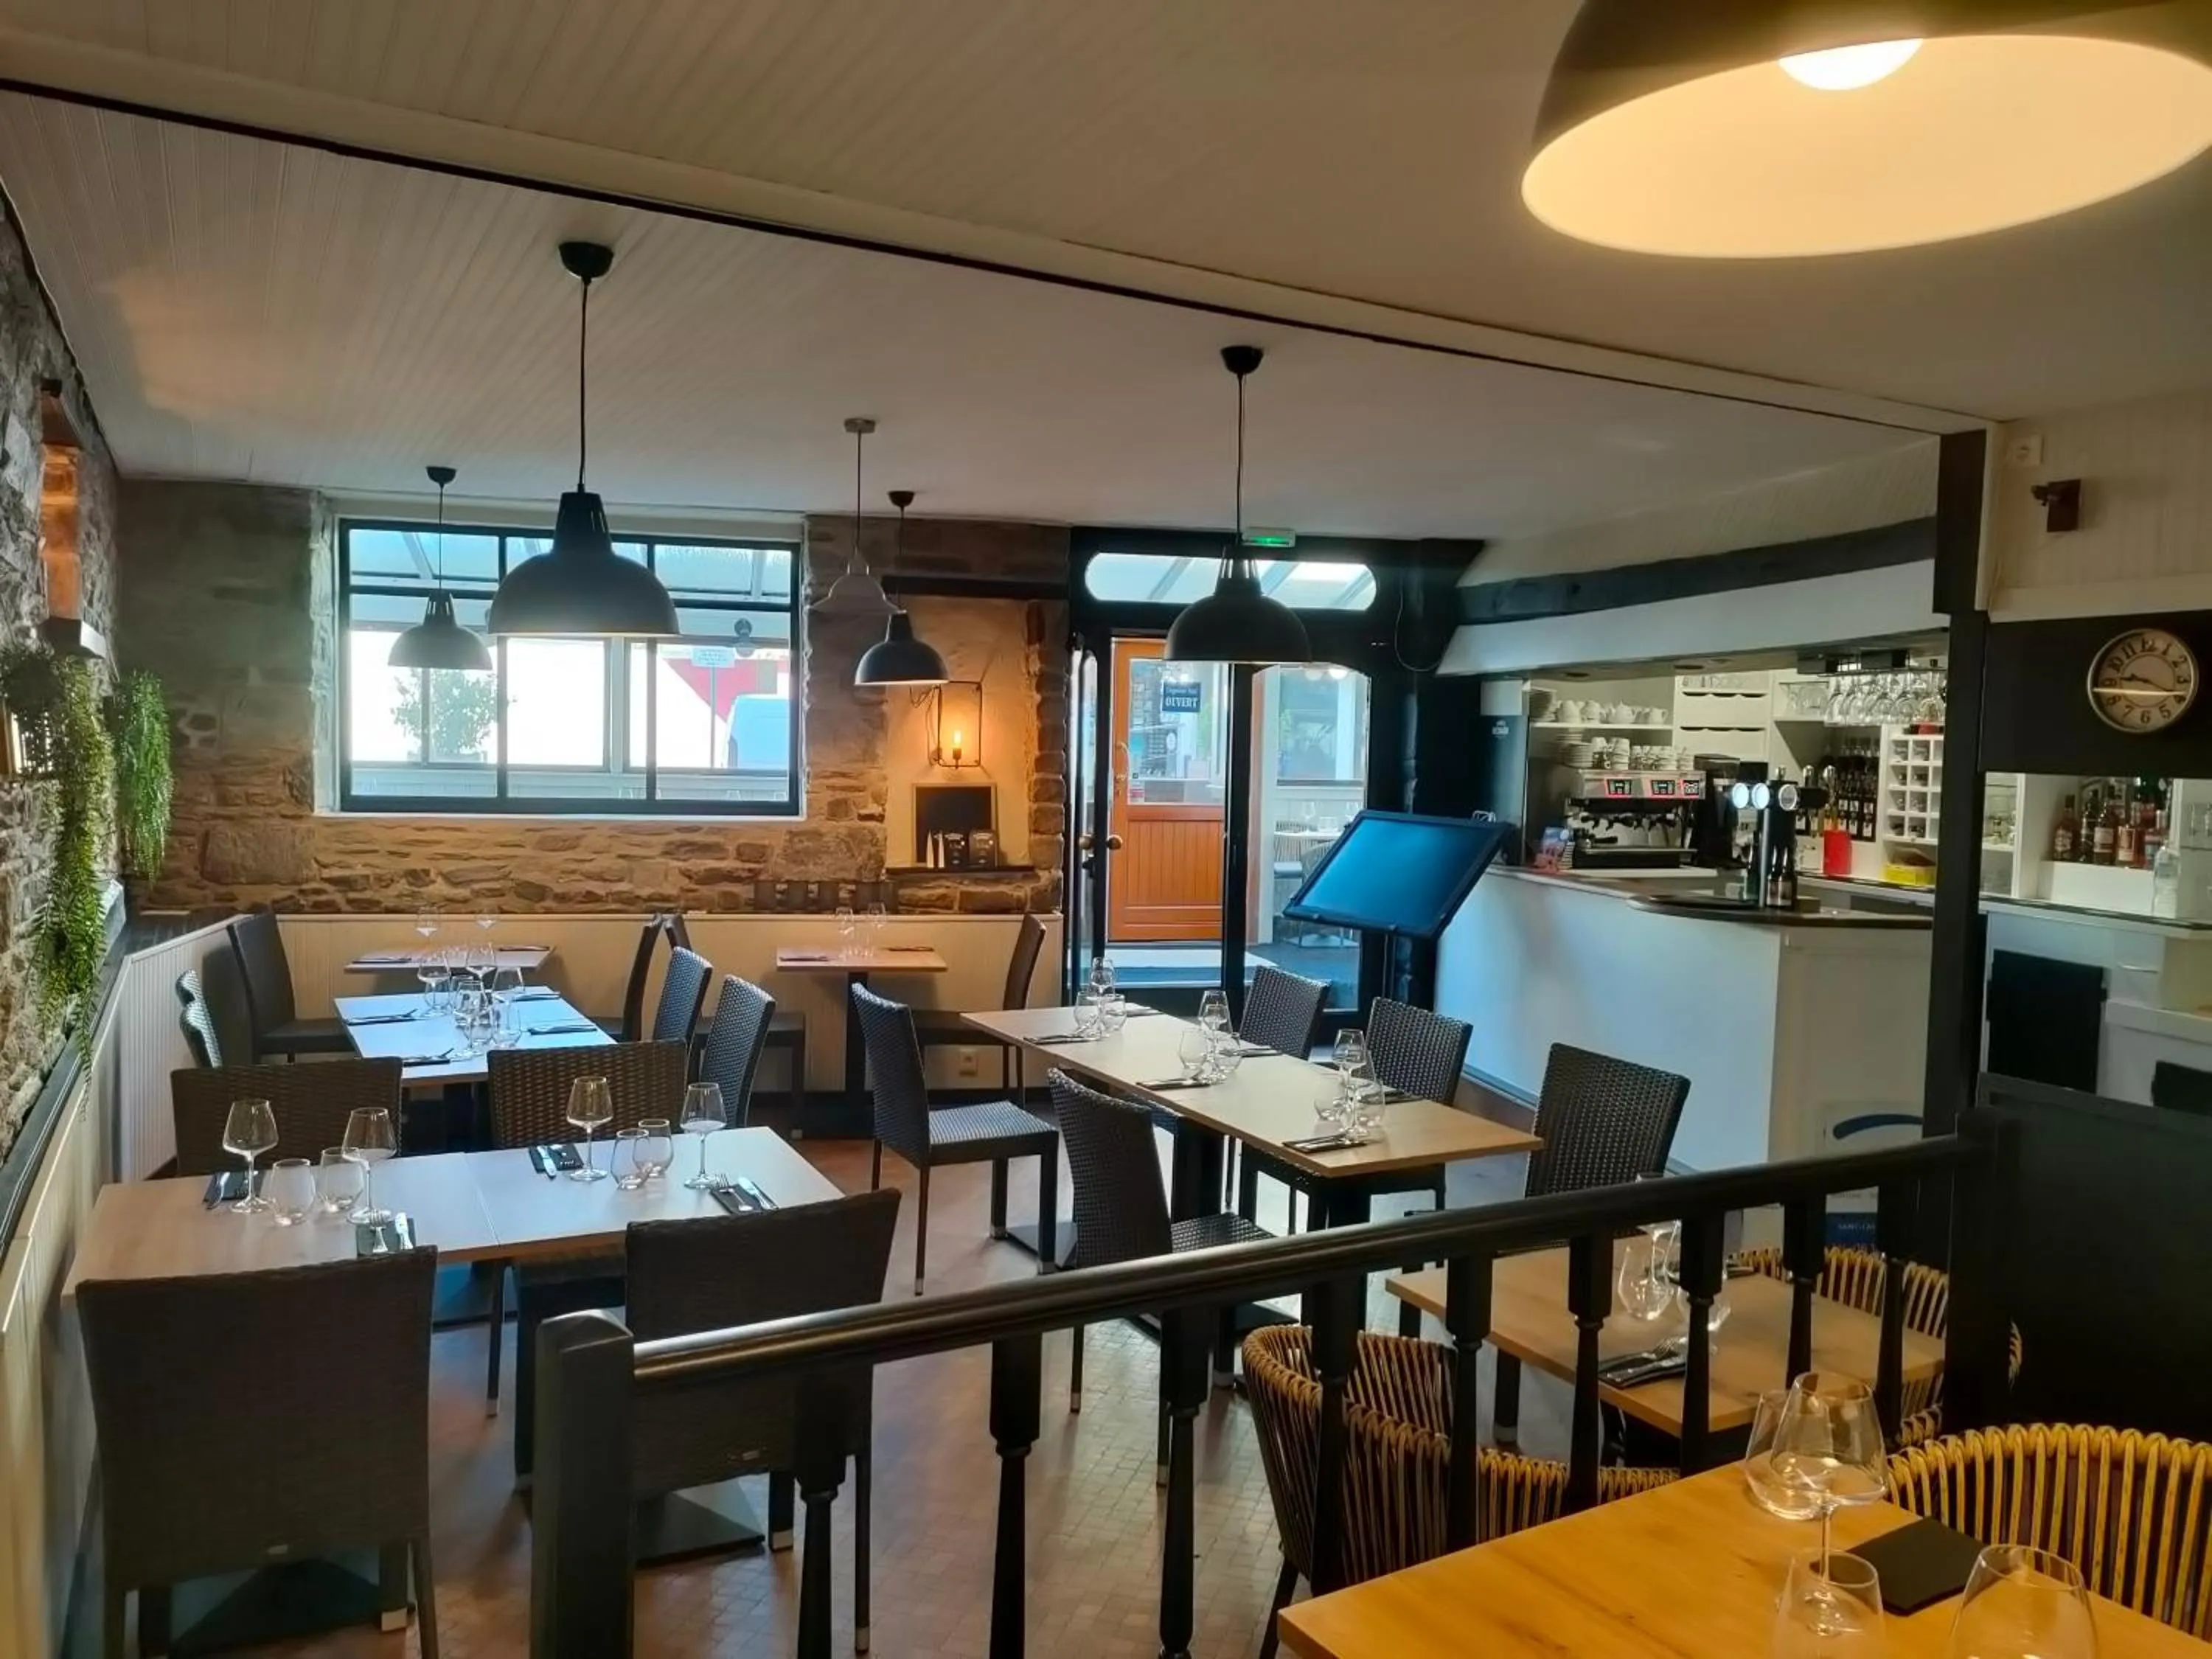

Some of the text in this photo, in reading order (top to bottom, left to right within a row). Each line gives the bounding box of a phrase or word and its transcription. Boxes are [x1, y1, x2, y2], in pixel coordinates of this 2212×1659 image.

[2140, 637, 2157, 653] 12
[2161, 642, 2172, 655] 1
[2172, 655, 2187, 668] 2
[2124, 704, 2135, 717] 7
[2140, 709, 2151, 724] 6
[2159, 704, 2171, 720] 5
